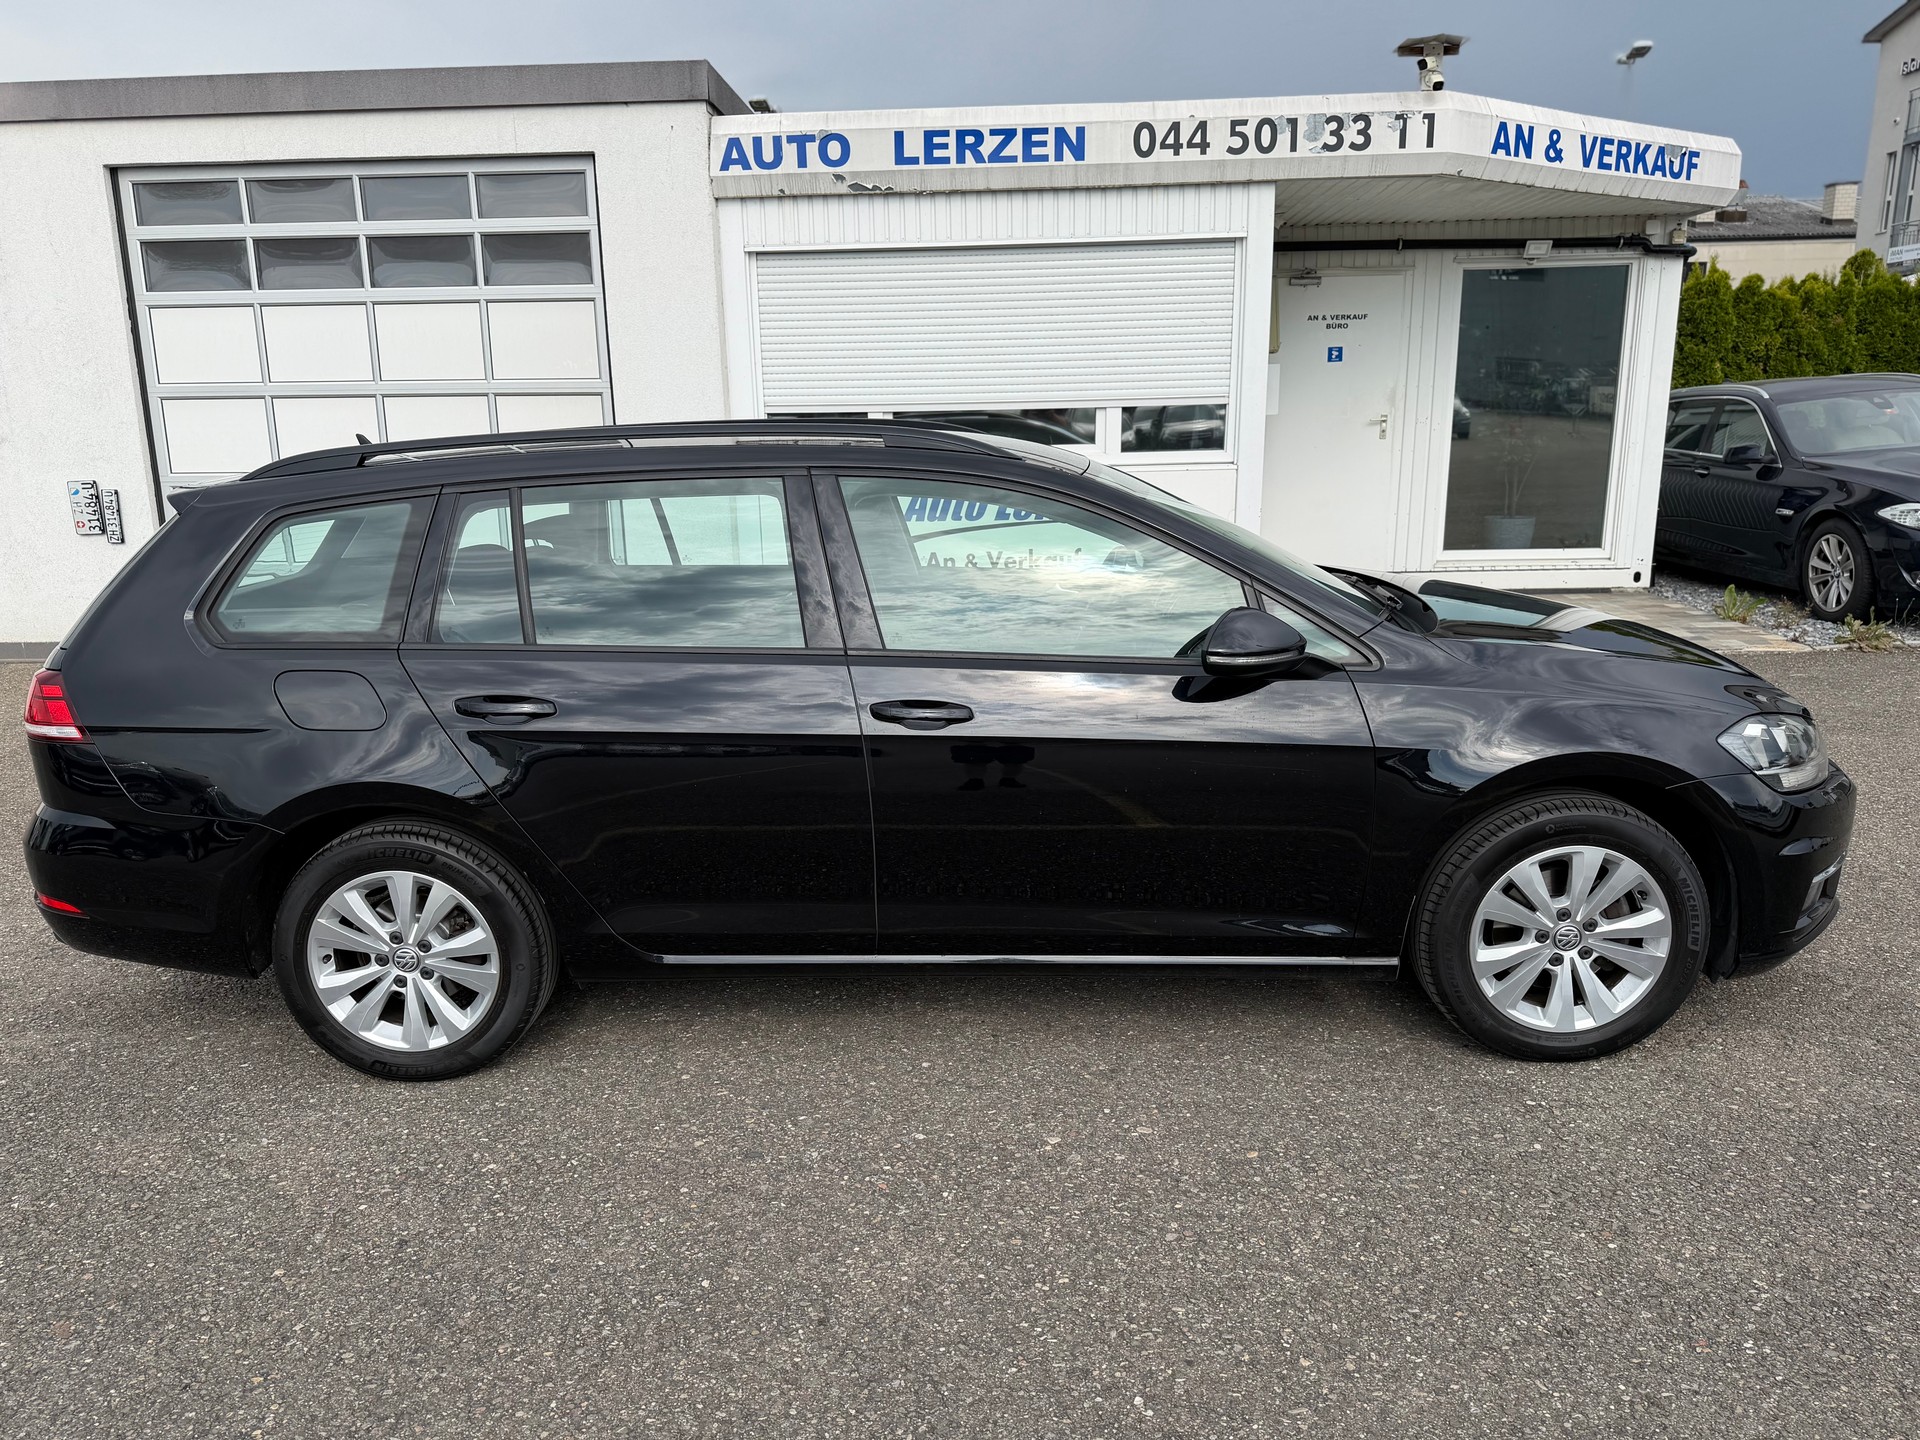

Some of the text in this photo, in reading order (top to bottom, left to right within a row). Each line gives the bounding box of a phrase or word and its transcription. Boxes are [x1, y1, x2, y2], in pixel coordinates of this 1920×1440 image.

[719, 112, 1436, 172] AUTO LERZEN 044 501 33 11
[1491, 121, 1701, 182] AN & VERKAUF
[1307, 314, 1319, 322] AN
[1329, 313, 1369, 321] VERKAUF
[1325, 322, 1349, 330] BÜRO
[72, 501, 84, 515] ZH
[926, 551, 956, 568] An
[964, 553, 978, 569] &
[1680, 877, 1700, 947] MICHELIN
